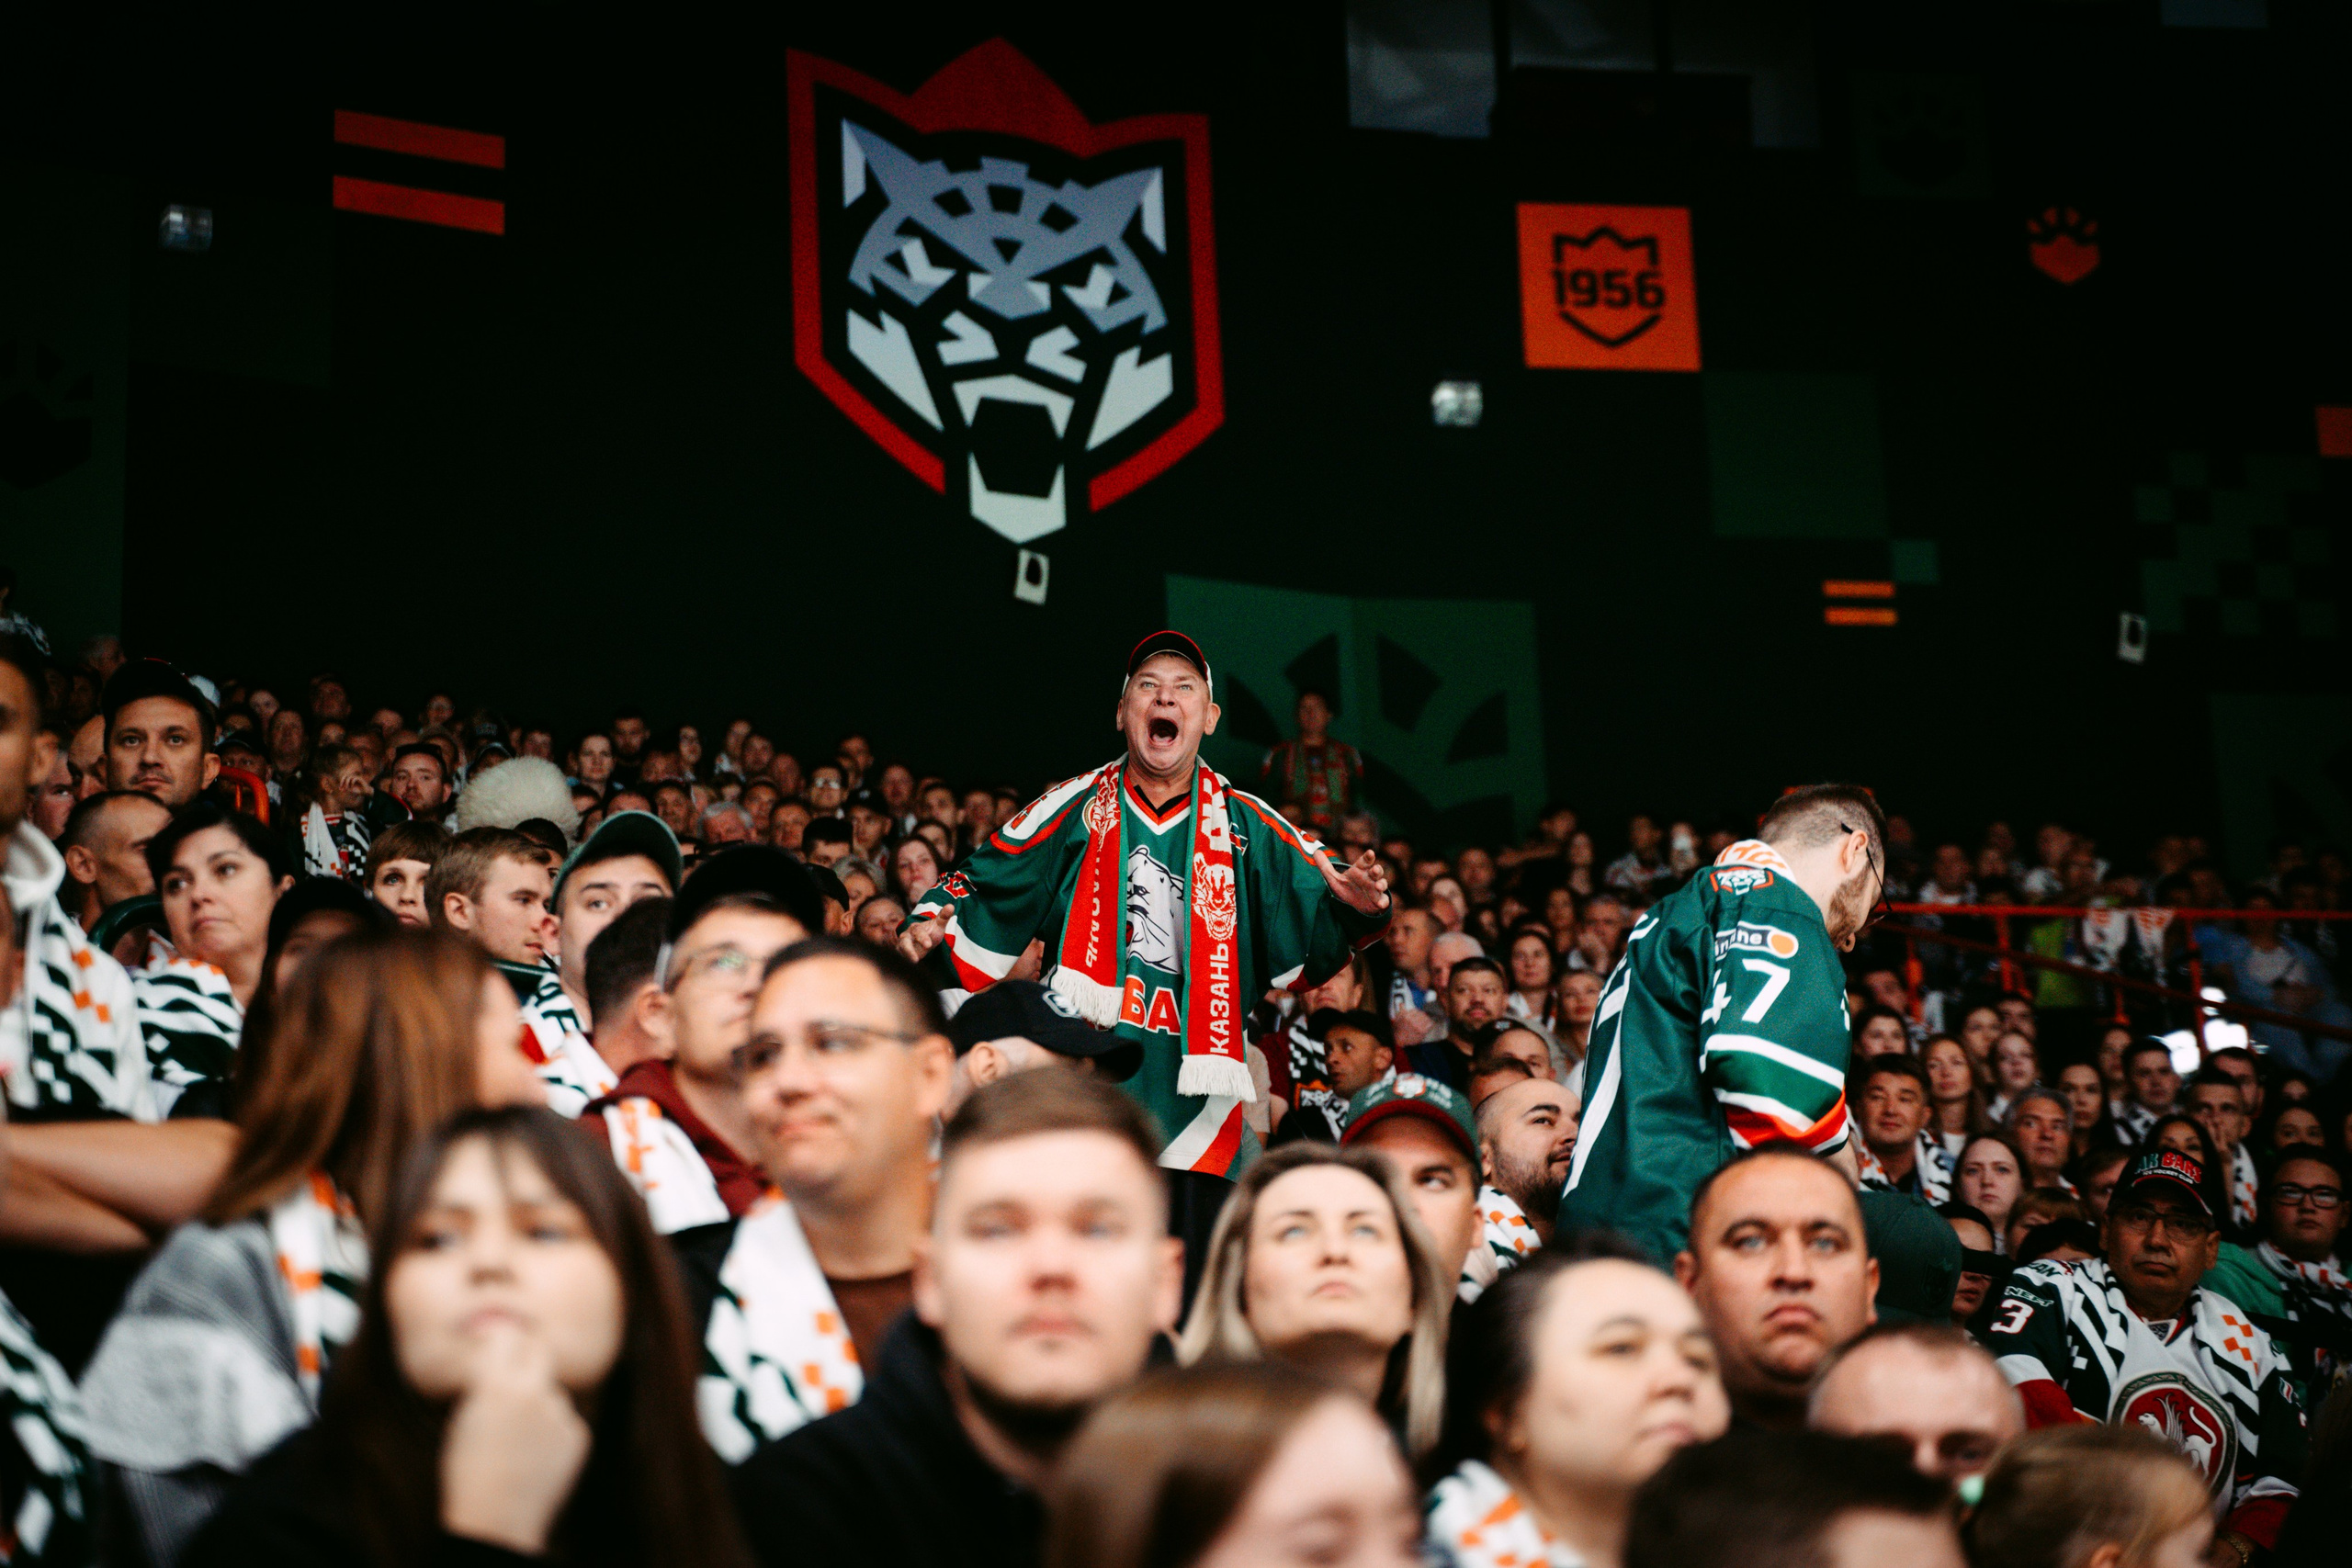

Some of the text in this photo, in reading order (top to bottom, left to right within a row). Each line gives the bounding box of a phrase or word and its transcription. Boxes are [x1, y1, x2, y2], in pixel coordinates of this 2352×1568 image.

[1552, 267, 1665, 308] 1956
[1118, 975, 1181, 1036] БА
[1210, 943, 1229, 1054] КАЗАНЬ
[2162, 1152, 2201, 1183] BARS
[2004, 1286, 2054, 1307] NEFT
